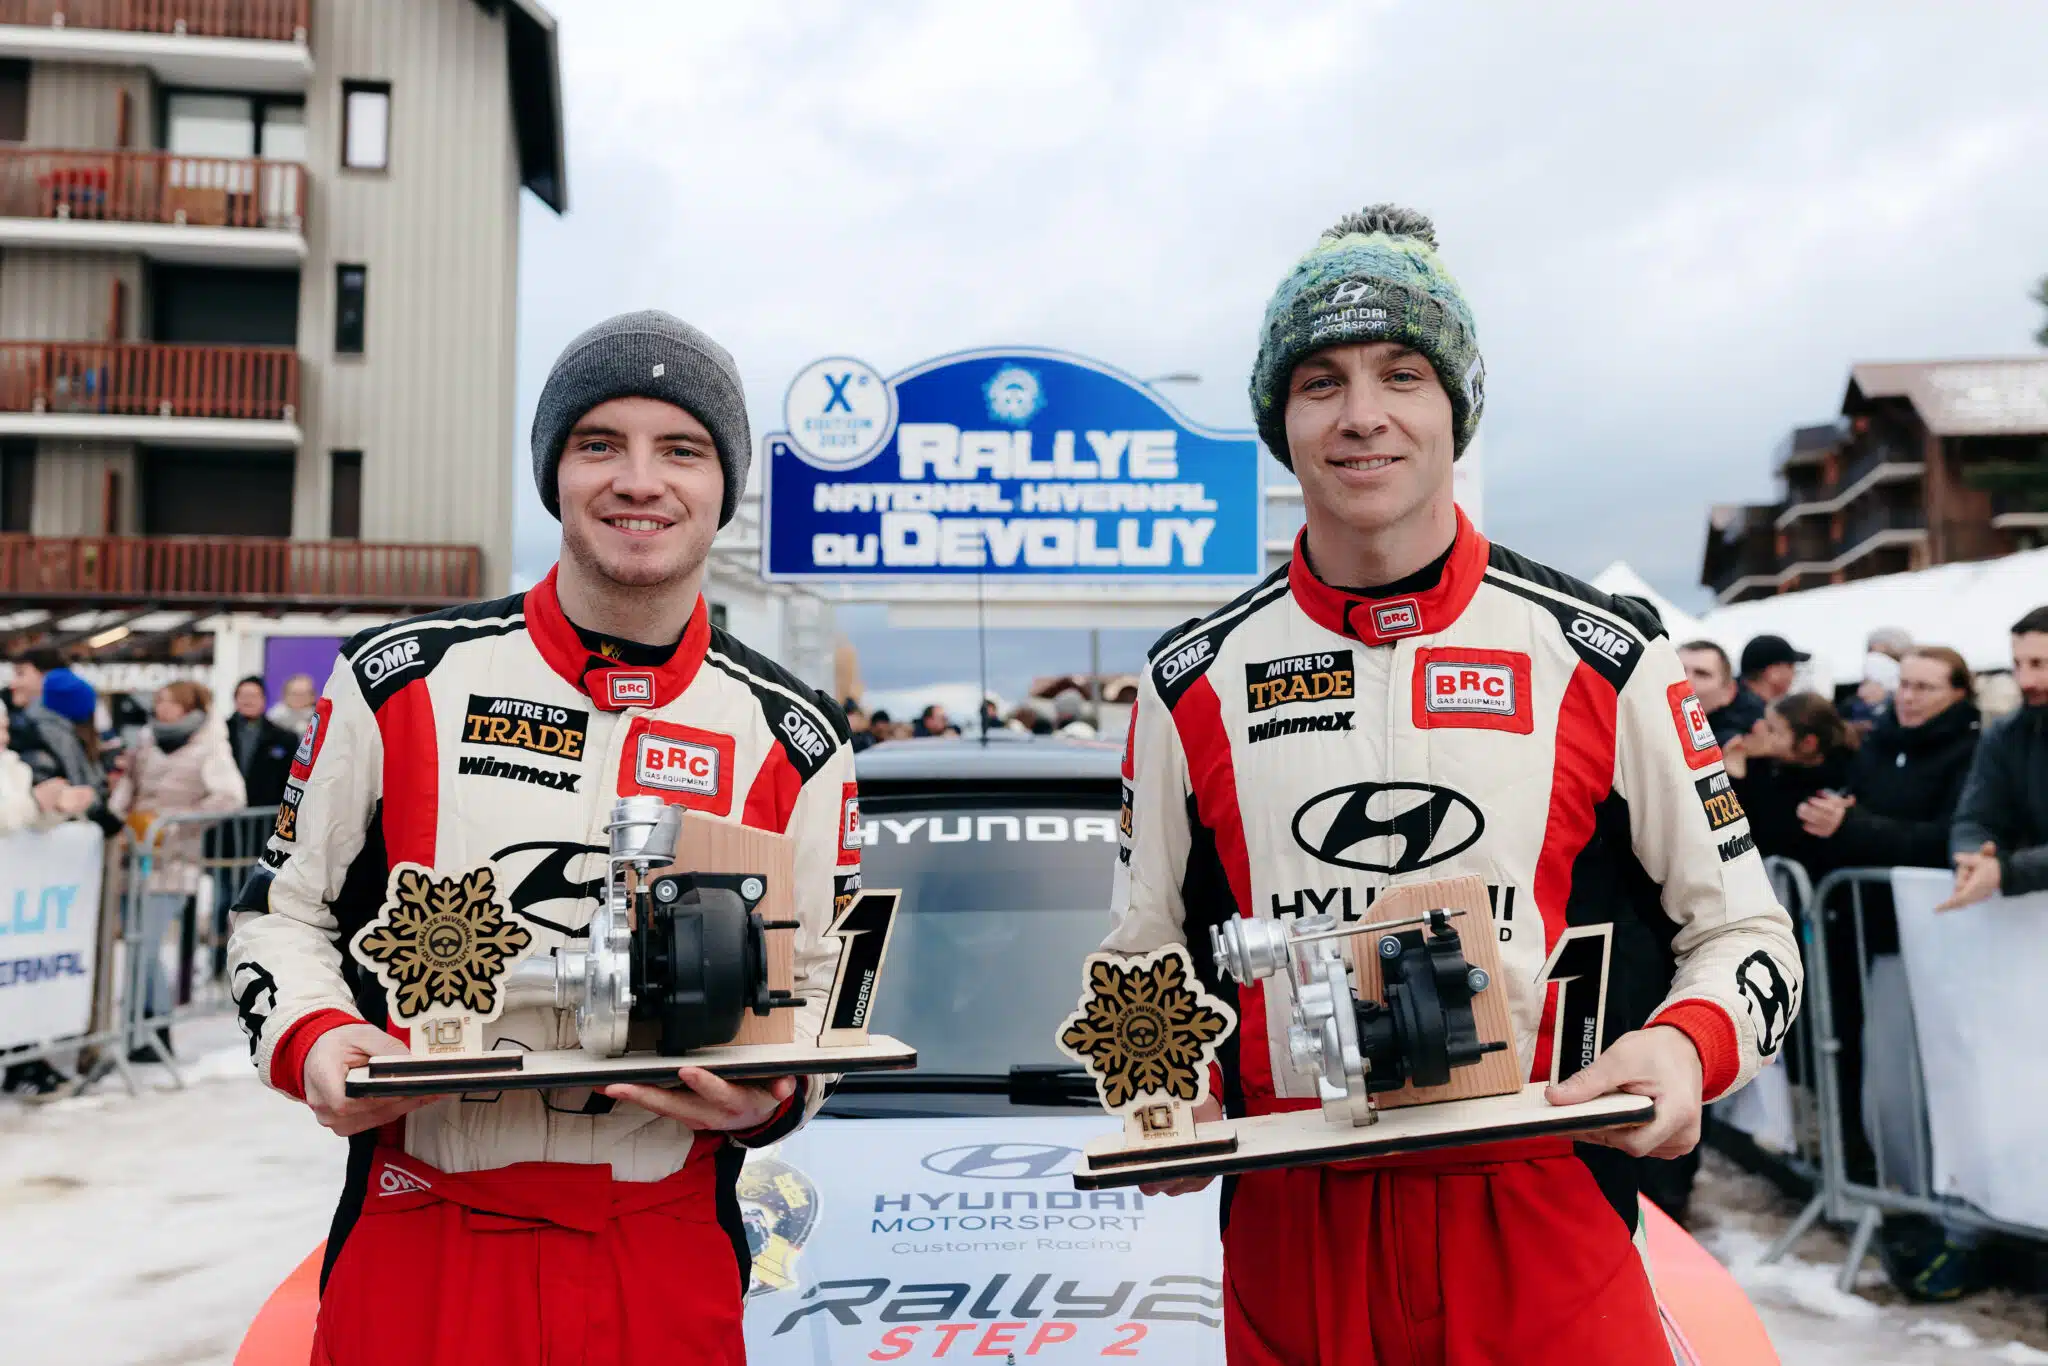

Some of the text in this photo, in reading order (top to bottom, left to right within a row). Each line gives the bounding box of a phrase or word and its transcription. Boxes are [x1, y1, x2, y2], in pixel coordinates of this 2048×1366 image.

[1313, 321, 1387, 337] MOTORSPORT
[1314, 308, 1387, 326] HYUNDAI
[898, 423, 1178, 479] RALLYE
[813, 482, 1218, 512] NATIONAL HIVERNAL
[880, 511, 1216, 567] DEVOLUY
[1383, 612, 1409, 625] BRC
[1571, 618, 1630, 657] OMP
[364, 640, 420, 681] OMP
[1162, 640, 1211, 680] OMP
[1266, 655, 1335, 678] MITRE 10
[618, 683, 645, 694] BRC
[1249, 671, 1352, 709] TRADE
[1436, 671, 1504, 696] BRC
[488, 699, 568, 724] MITRE 10
[1437, 697, 1506, 707] GAS EQUIPMENT
[467, 714, 584, 758] TRADE
[783, 711, 825, 758] OMP
[645, 747, 709, 777] BRC
[645, 771, 709, 787] GAS EQUIPMENT
[860, 816, 1118, 845] HYUNDA
[418, 914, 473, 947] RALLYE HIVERNAL
[421, 948, 470, 968] DU DEVOLUY
[852, 969, 874, 1026] MODERNE
[1581, 1016, 1596, 1069] ODERNE
[874, 1191, 1145, 1213] HYUNDAI
[871, 1215, 1146, 1233] MOTORSPORT
[891, 1238, 1132, 1255] Customer Racing
[772, 1273, 1223, 1336] Rally2
[868, 1322, 1149, 1361] STEP 2
